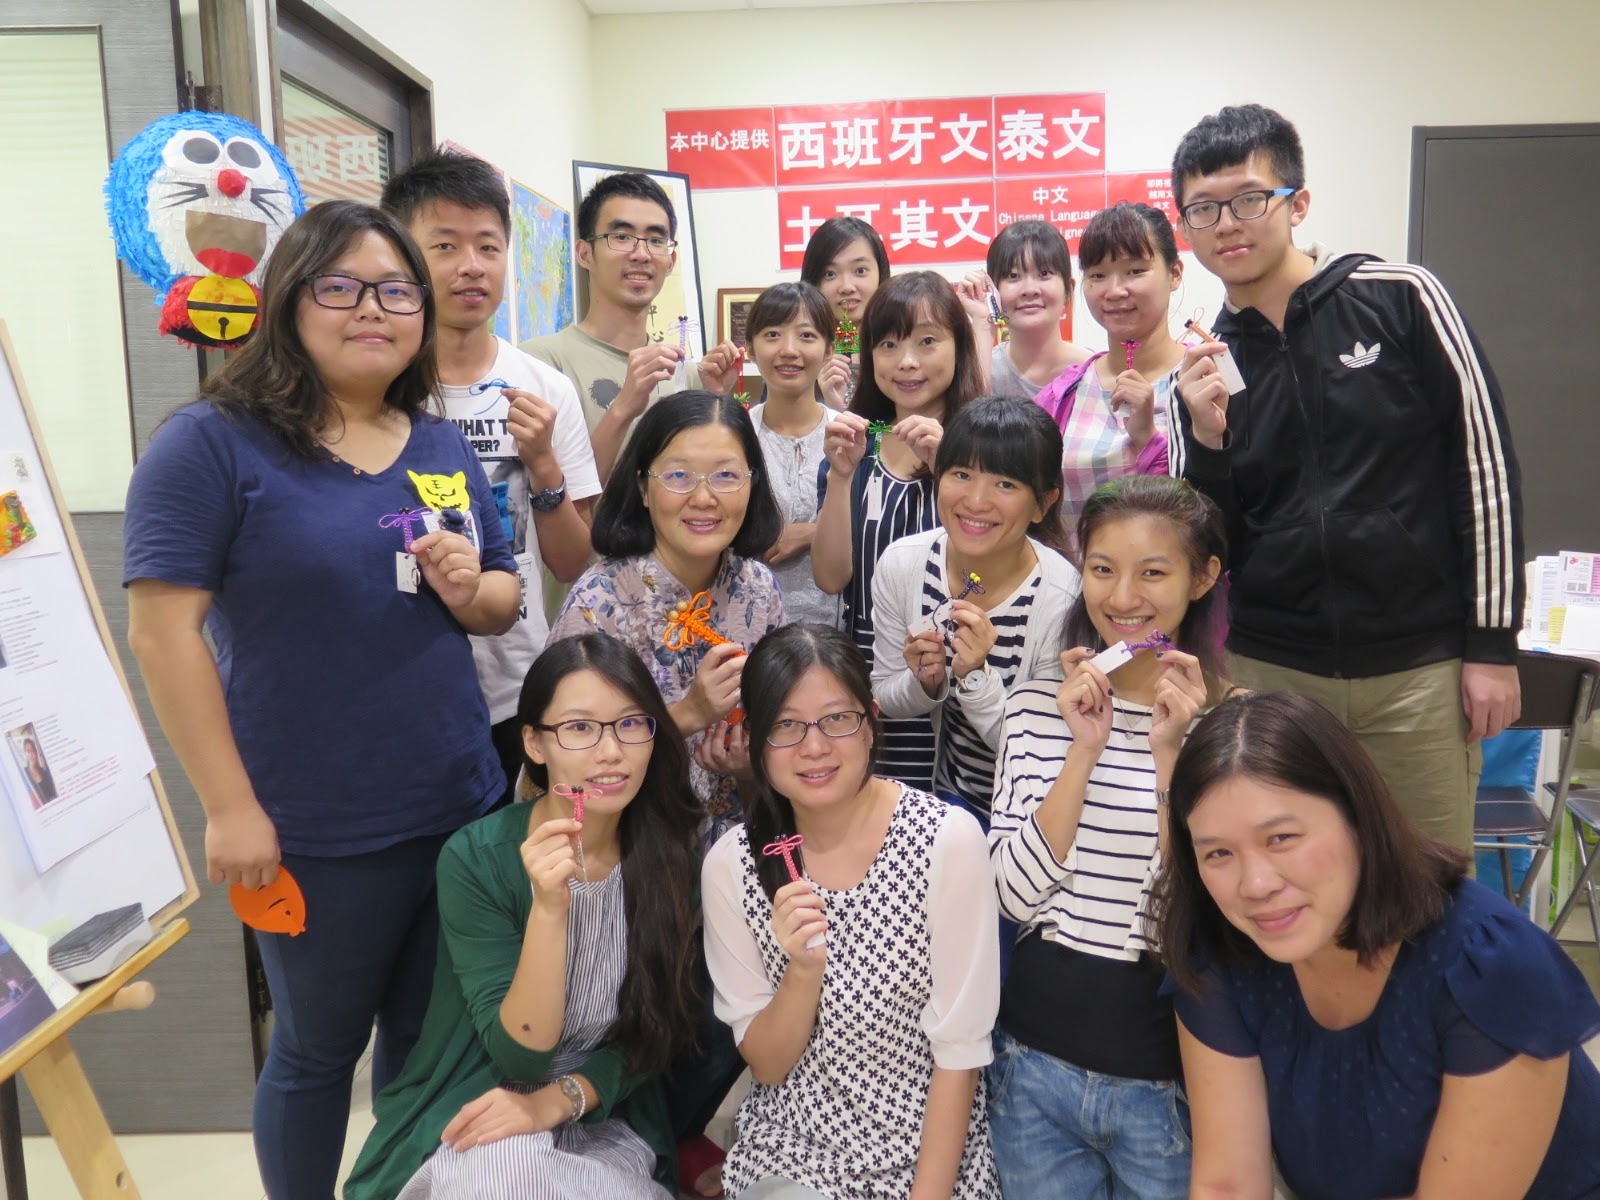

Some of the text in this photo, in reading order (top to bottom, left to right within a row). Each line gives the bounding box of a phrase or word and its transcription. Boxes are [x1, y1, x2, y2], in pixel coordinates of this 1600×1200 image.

[670, 109, 1101, 170] 本中心提供 西班牙文 泰文
[1033, 186, 1069, 205] 中文
[1050, 209, 1104, 222] Languag
